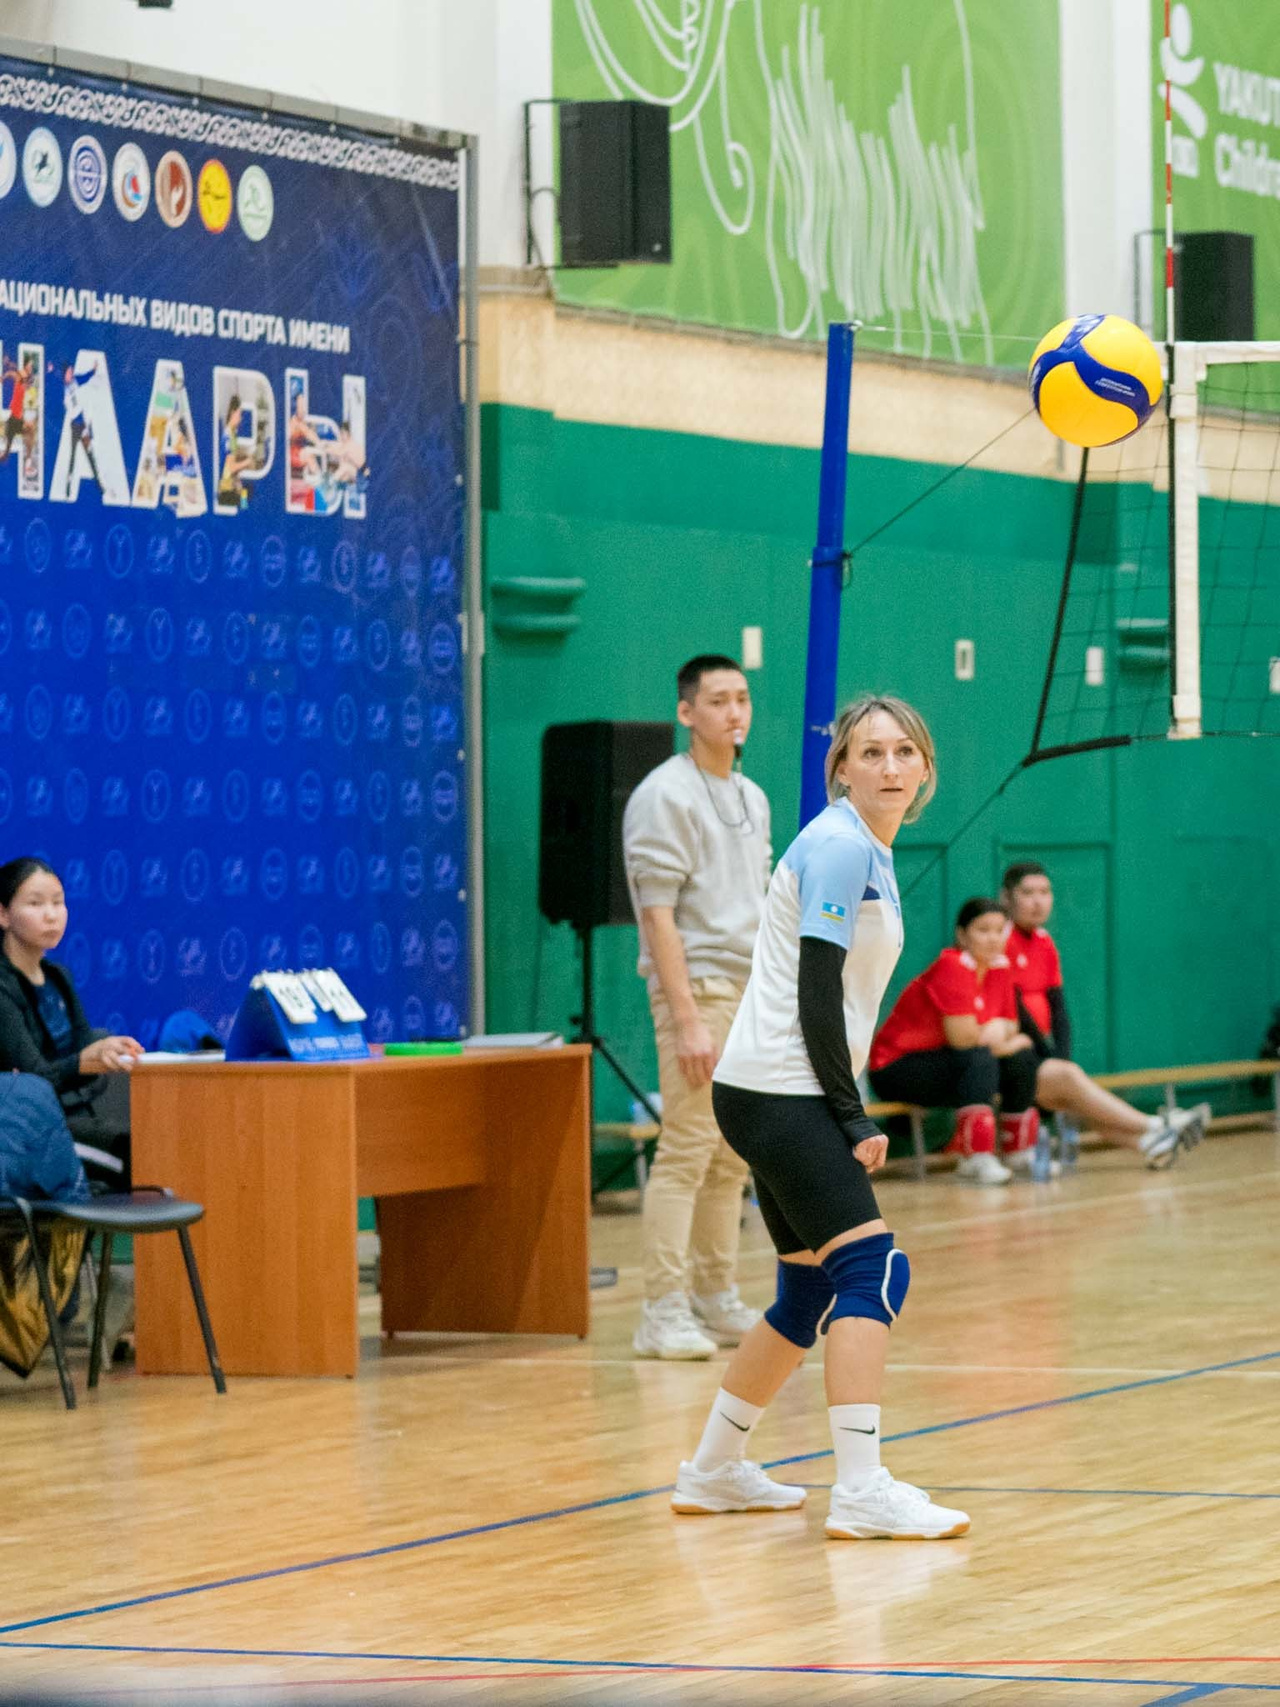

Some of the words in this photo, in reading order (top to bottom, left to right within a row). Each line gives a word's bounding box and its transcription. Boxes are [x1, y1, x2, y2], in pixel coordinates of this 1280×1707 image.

[0, 278, 148, 327] АЦИОНАЛЬНЫХ
[150, 299, 215, 338] ВИДОВ
[217, 308, 287, 346] СПОРТА
[288, 318, 350, 354] ИМЕНИ
